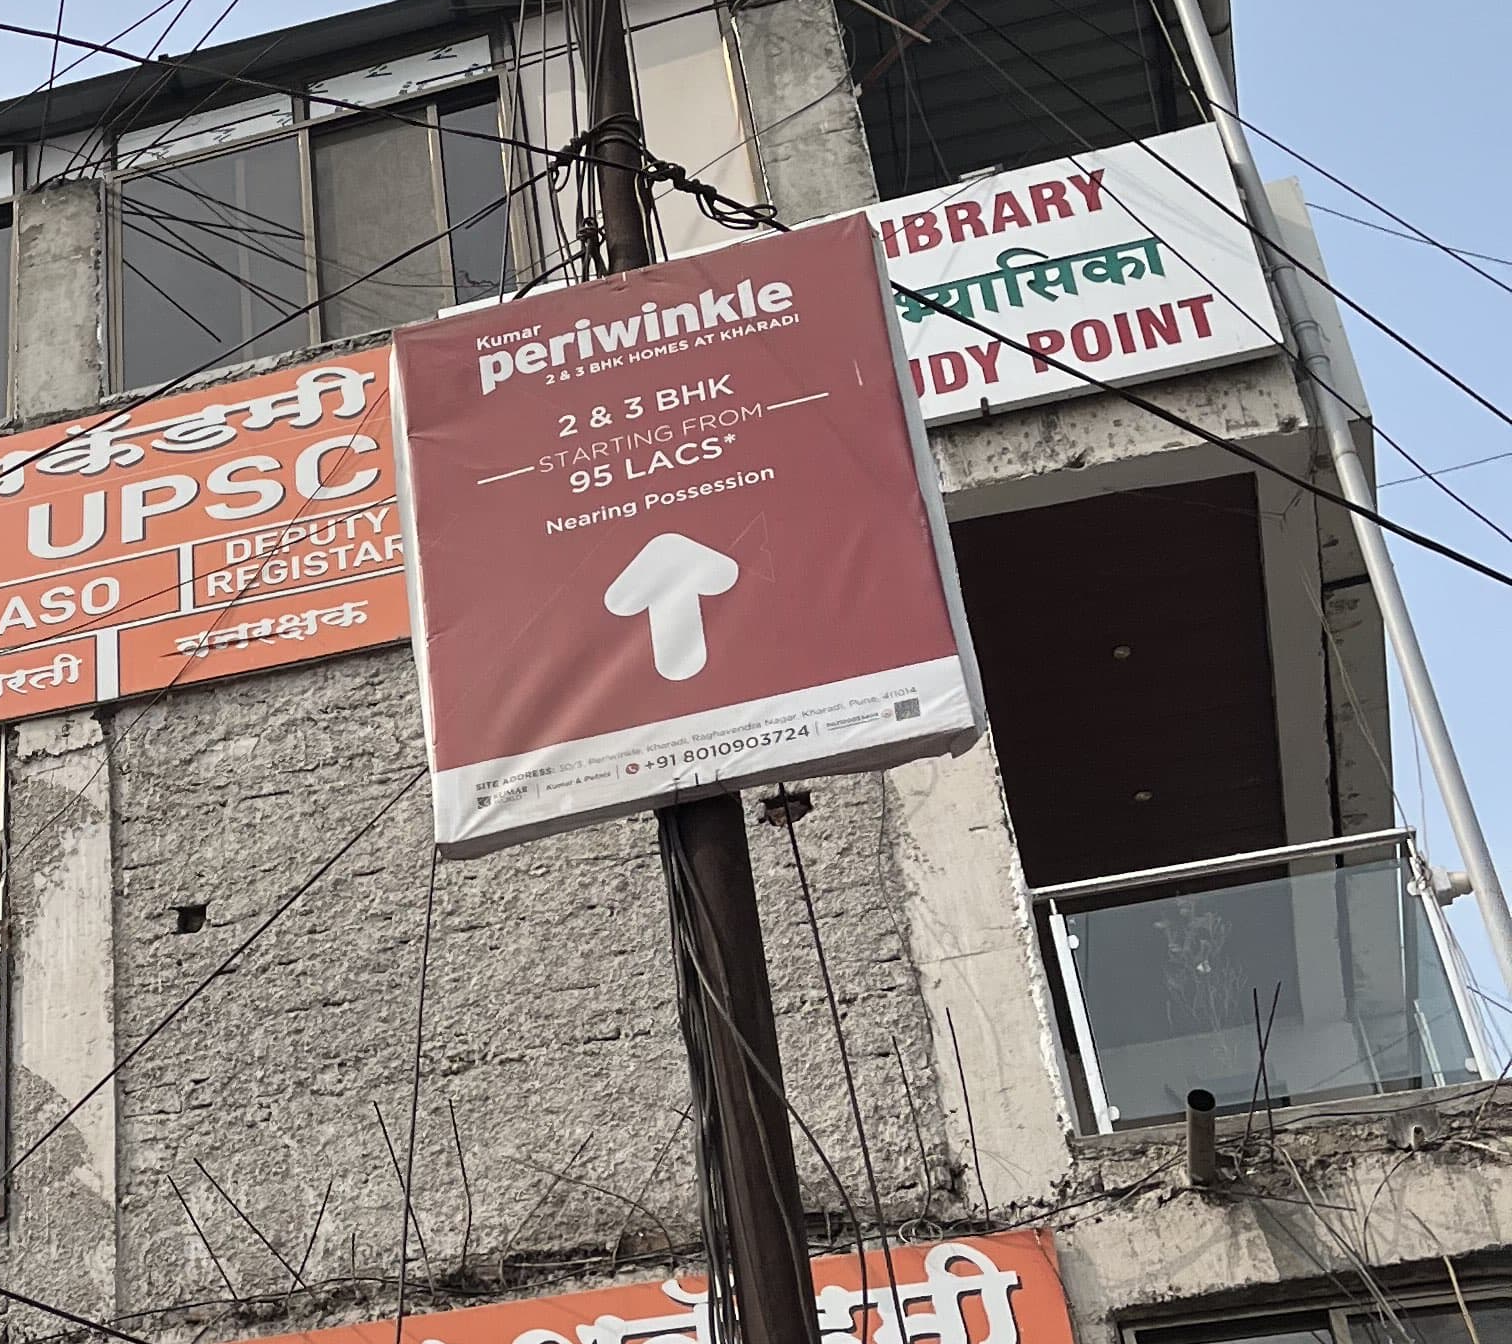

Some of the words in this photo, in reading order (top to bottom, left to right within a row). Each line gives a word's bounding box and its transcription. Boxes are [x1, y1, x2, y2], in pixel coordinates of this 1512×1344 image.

[880, 168, 1106, 258] IBRARY
[895, 232, 1166, 323] भ्यासिका
[476, 324, 543, 351] Kumar
[477, 278, 794, 395] periwinkle
[545, 373, 556, 385] 2
[559, 370, 571, 381] &
[575, 366, 585, 378] 3
[589, 356, 624, 374] BHK
[629, 340, 690, 364] HOMES
[694, 333, 715, 347] AT
[720, 313, 800, 342] KHARADI
[1026, 294, 1214, 374] POINT
[538, 424, 674, 473] STARTING
[683, 402, 763, 436] FROM
[558, 414, 579, 438] 2
[589, 406, 614, 429] &
[623, 396, 645, 420] 3
[656, 373, 735, 412] BHK
[28, 433, 381, 561] UPSC
[546, 501, 638, 535] Nearing
[644, 466, 776, 510] Possession
[569, 464, 614, 494] 95
[206, 532, 405, 598] REGISTAR
[225, 506, 391, 565] DEPUTY
[645, 753, 677, 771] +91
[683, 724, 810, 764] 8010903724
[475, 779, 499, 791] SITE
